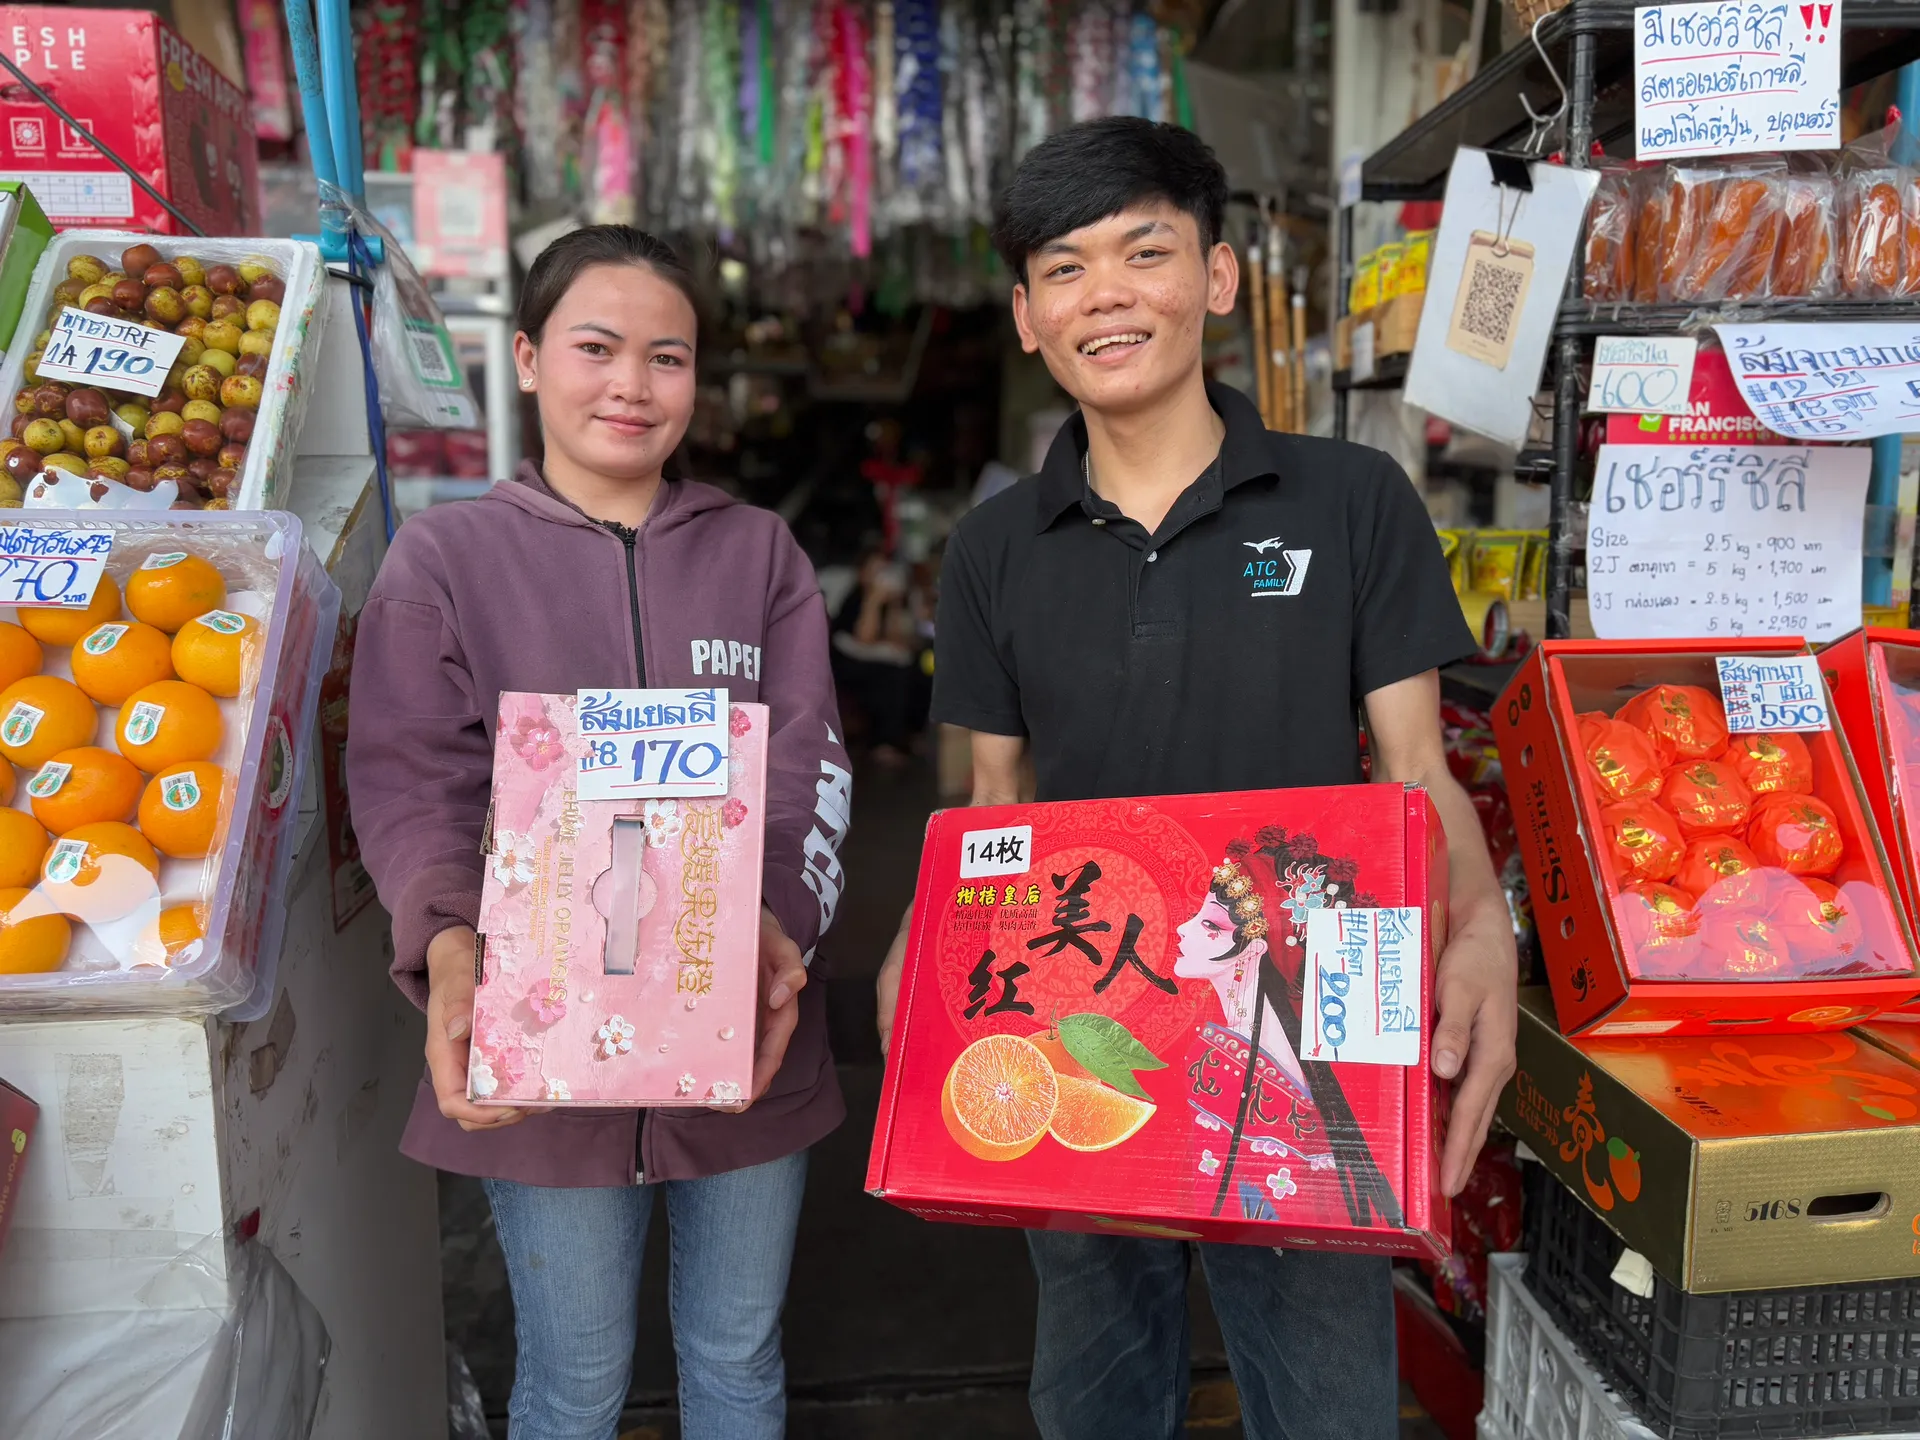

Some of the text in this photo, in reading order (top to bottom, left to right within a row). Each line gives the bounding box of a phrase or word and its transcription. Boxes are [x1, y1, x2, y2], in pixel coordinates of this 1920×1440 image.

[1684, 401, 1711, 416] AN
[1668, 416, 1766, 432] FRANCISC
[1590, 526, 1629, 548] Size
[1703, 533, 1732, 552] 2.5
[1736, 540, 1751, 560] kg
[1766, 537, 1796, 553] 900
[1243, 560, 1278, 577] ATC
[1592, 556, 1621, 574] 2J
[1705, 562, 1718, 576] 5
[1731, 562, 1746, 581] kg
[1768, 560, 1803, 577] 1,700
[1253, 578, 1287, 588] FAMILY
[1703, 592, 1731, 606] 2.5
[1735, 592, 1749, 612] kg
[1772, 592, 1809, 608] 1,500
[1706, 617, 1718, 631] 5
[1730, 618, 1744, 637] kg
[1767, 616, 1808, 631] 2,950
[966, 834, 1025, 865] 14枚
[1531, 779, 1570, 905] Spring
[555, 851, 575, 903] JELLY
[956, 883, 1042, 908] 柑桔皇后
[549, 907, 573, 1001] ORANGES
[1516, 1069, 1561, 1127] Citrus
[1743, 1198, 1801, 1222] 5168
